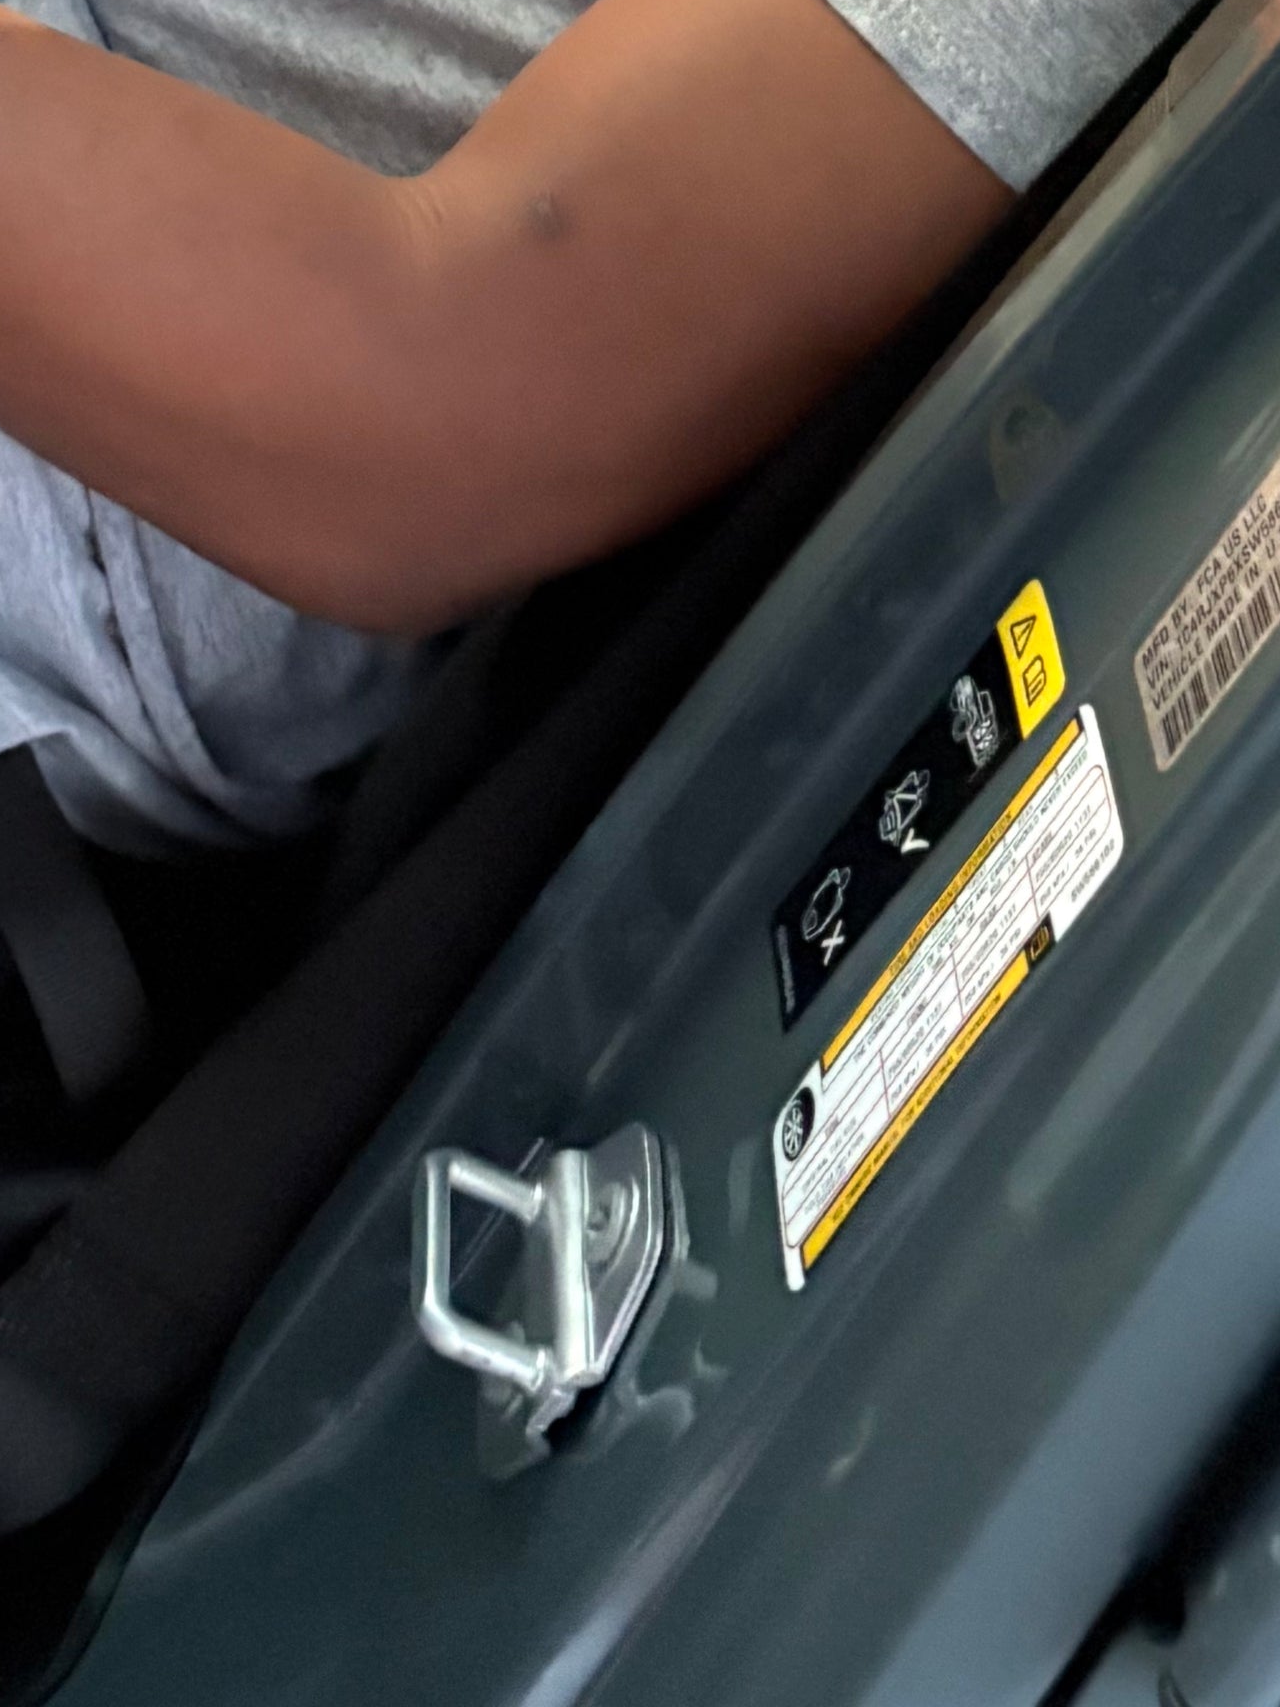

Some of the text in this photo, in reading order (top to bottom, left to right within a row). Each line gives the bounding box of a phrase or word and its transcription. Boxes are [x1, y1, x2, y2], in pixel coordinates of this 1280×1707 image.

[1141, 623, 1169, 672] MFD
[1195, 552, 1221, 597] FCA
[1222, 524, 1242, 561] US
[1242, 490, 1267, 534] LLC
[1151, 632, 1204, 716] VEHICLE
[1204, 582, 1242, 643] MADE
[1242, 559, 1259, 592] IN
